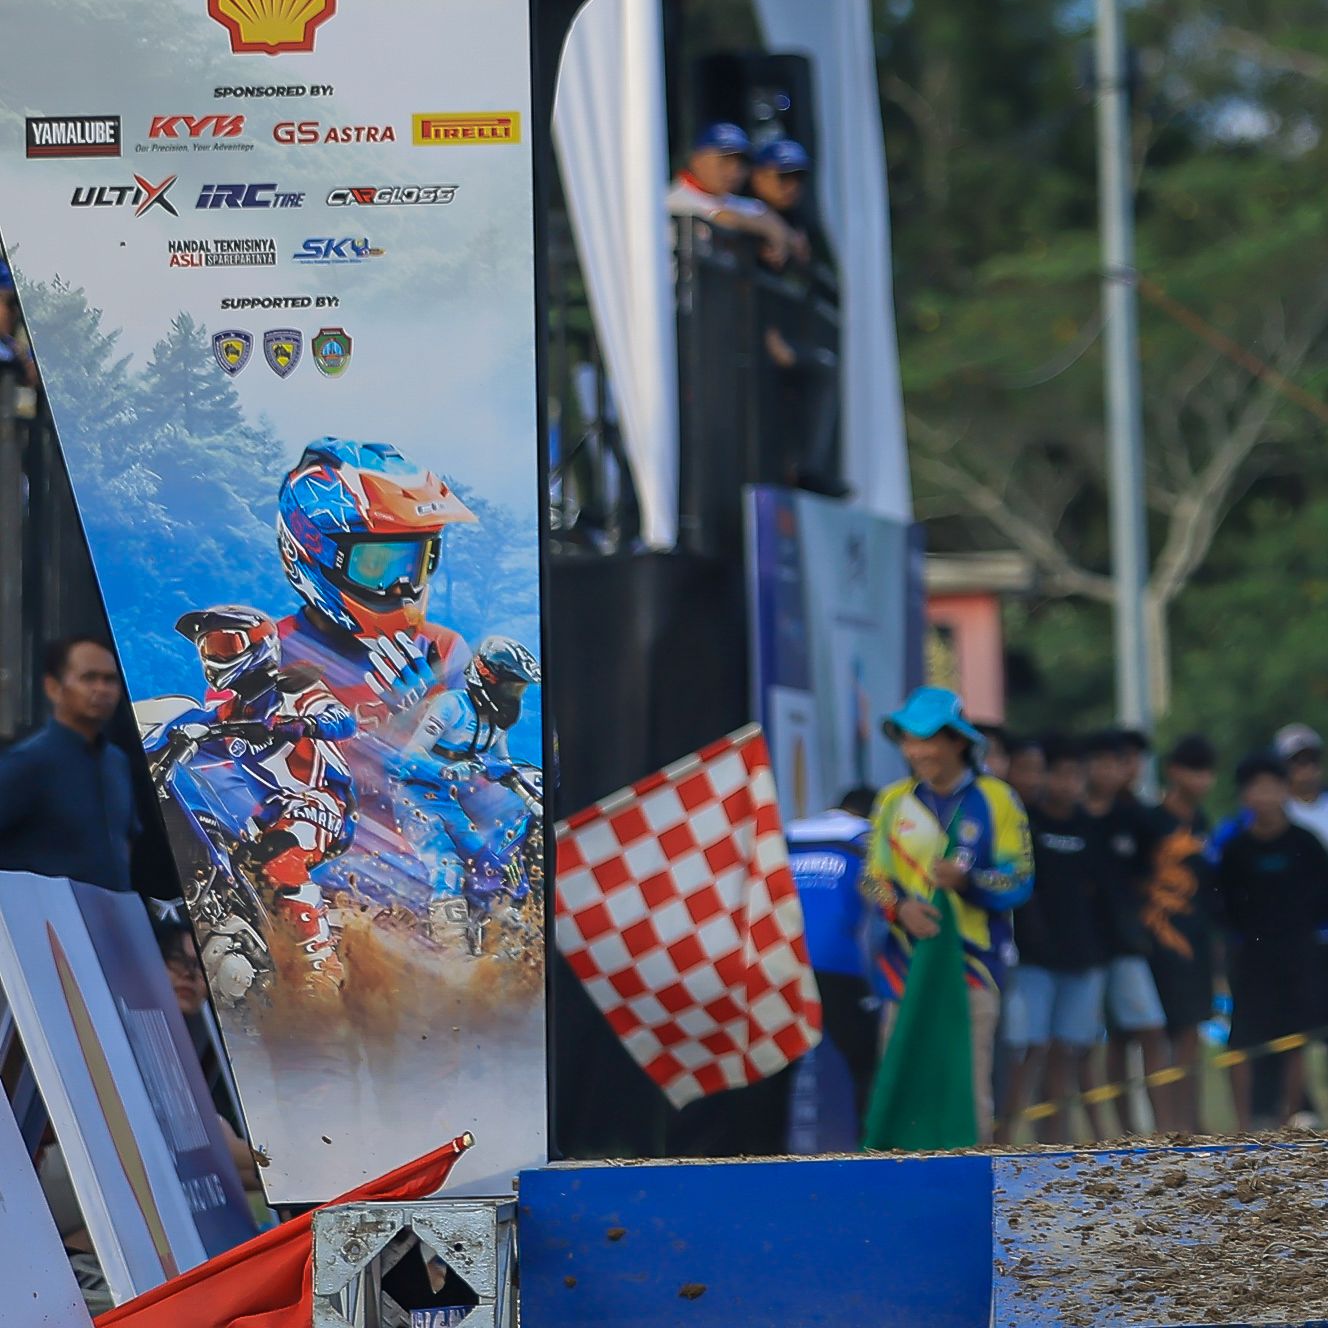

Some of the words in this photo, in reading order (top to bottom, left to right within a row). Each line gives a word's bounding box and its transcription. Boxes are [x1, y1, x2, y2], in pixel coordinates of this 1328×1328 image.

[213, 85, 306, 99] SPONSORED
[310, 84, 335, 97] BY:
[31, 120, 116, 145] YAMALUBE
[149, 114, 247, 139] KYB
[273, 121, 320, 145] GS
[324, 125, 396, 144] ASTRA
[421, 118, 512, 140] PIRELLI
[272, 192, 306, 208] TIRE
[326, 184, 460, 206] CARGLOSS
[168, 239, 212, 253] HANDAL
[213, 238, 276, 253] TEKNISINYA
[293, 237, 370, 259] SKY
[169, 253, 203, 268] ASLI
[220, 297, 313, 310] SUPPORTED
[316, 295, 340, 308] BY:
